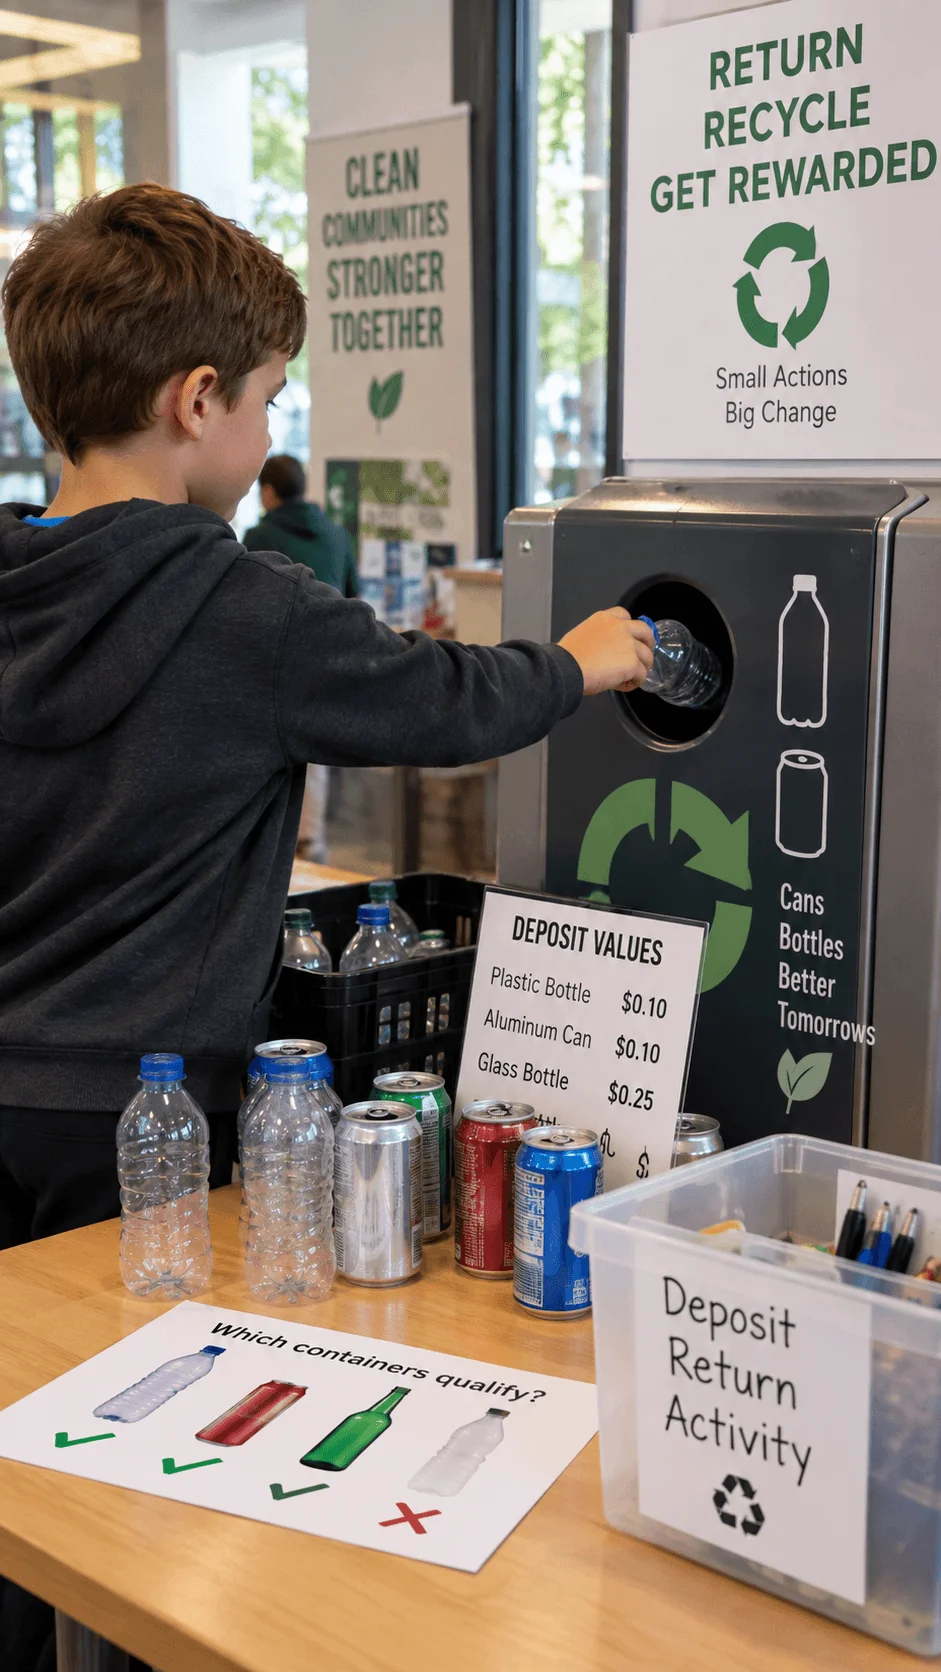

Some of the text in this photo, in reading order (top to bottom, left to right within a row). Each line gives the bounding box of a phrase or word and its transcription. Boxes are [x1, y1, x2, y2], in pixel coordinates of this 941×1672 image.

[710, 23, 863, 91] RETURN
[704, 84, 871, 149] RECYCLE
[346, 147, 419, 199] CLEAN
[651, 138, 938, 213] GET REWARDED
[322, 200, 448, 248] COMMUNITIES
[327, 250, 444, 301] STRONGER
[330, 306, 443, 352] TOGETHER
[717, 364, 847, 389] Small Actions
[726, 400, 836, 429] Big Change
[781, 883, 824, 915] Cans
[512, 916, 663, 965] DEPOSIT VALUES
[780, 922, 843, 960] Bottles
[491, 967, 667, 1018] Plastic Bottle $0.10
[779, 962, 835, 997] Better
[484, 1009, 660, 1063] Aluminum Can $0.10
[778, 1000, 876, 1046] Tomorrows
[478, 1052, 654, 1110] Glass Bottle $0.25
[663, 1276, 796, 1348] Deposit
[210, 1322, 546, 1402] Which containers qualify?
[668, 1336, 797, 1410] Return
[665, 1395, 812, 1486] Activity
